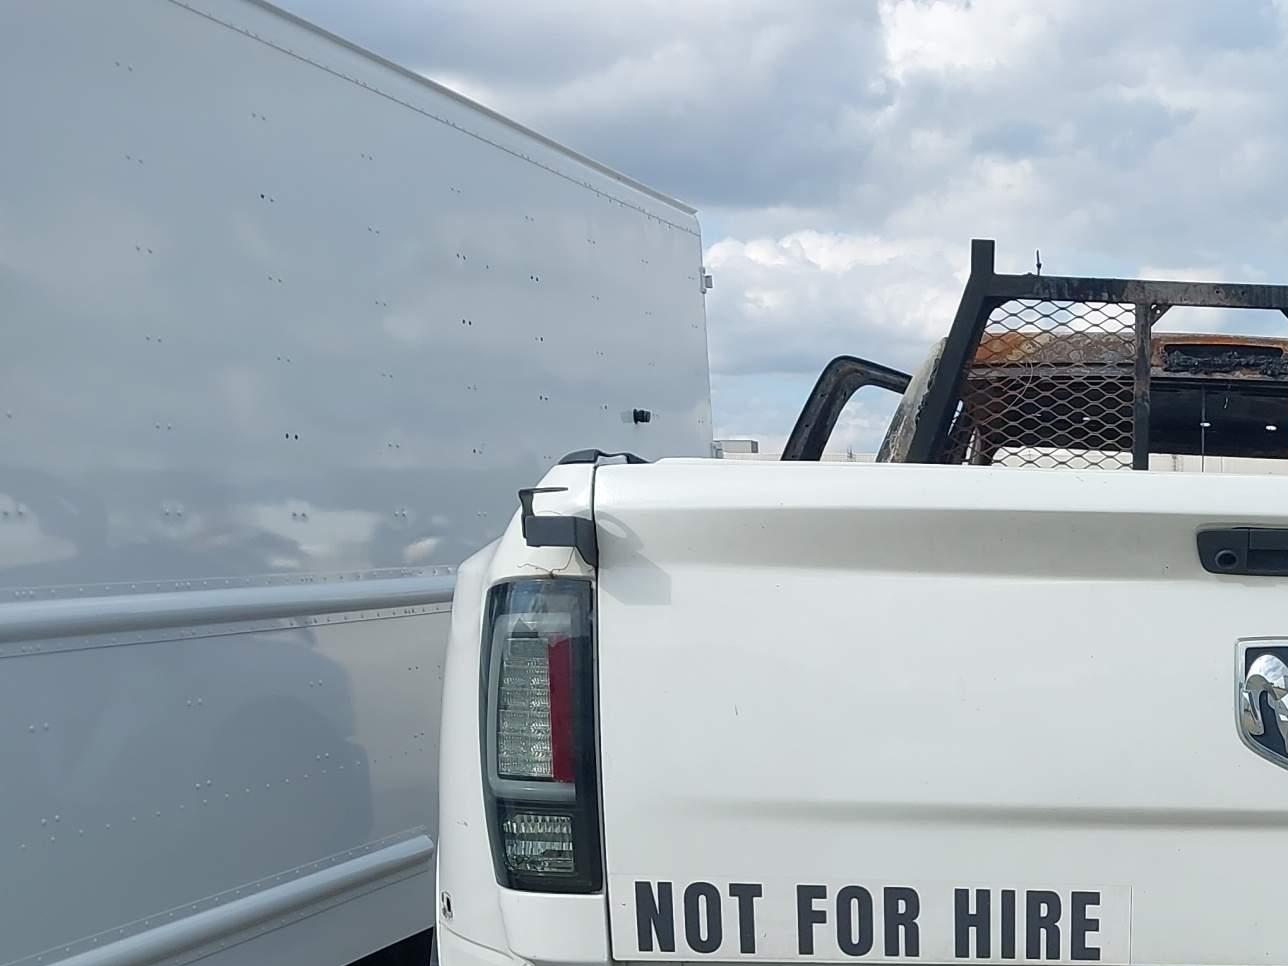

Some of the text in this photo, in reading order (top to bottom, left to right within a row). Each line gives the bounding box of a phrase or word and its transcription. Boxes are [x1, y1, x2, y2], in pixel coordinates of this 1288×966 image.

[634, 880, 1101, 961] NOT FOR HIRE
